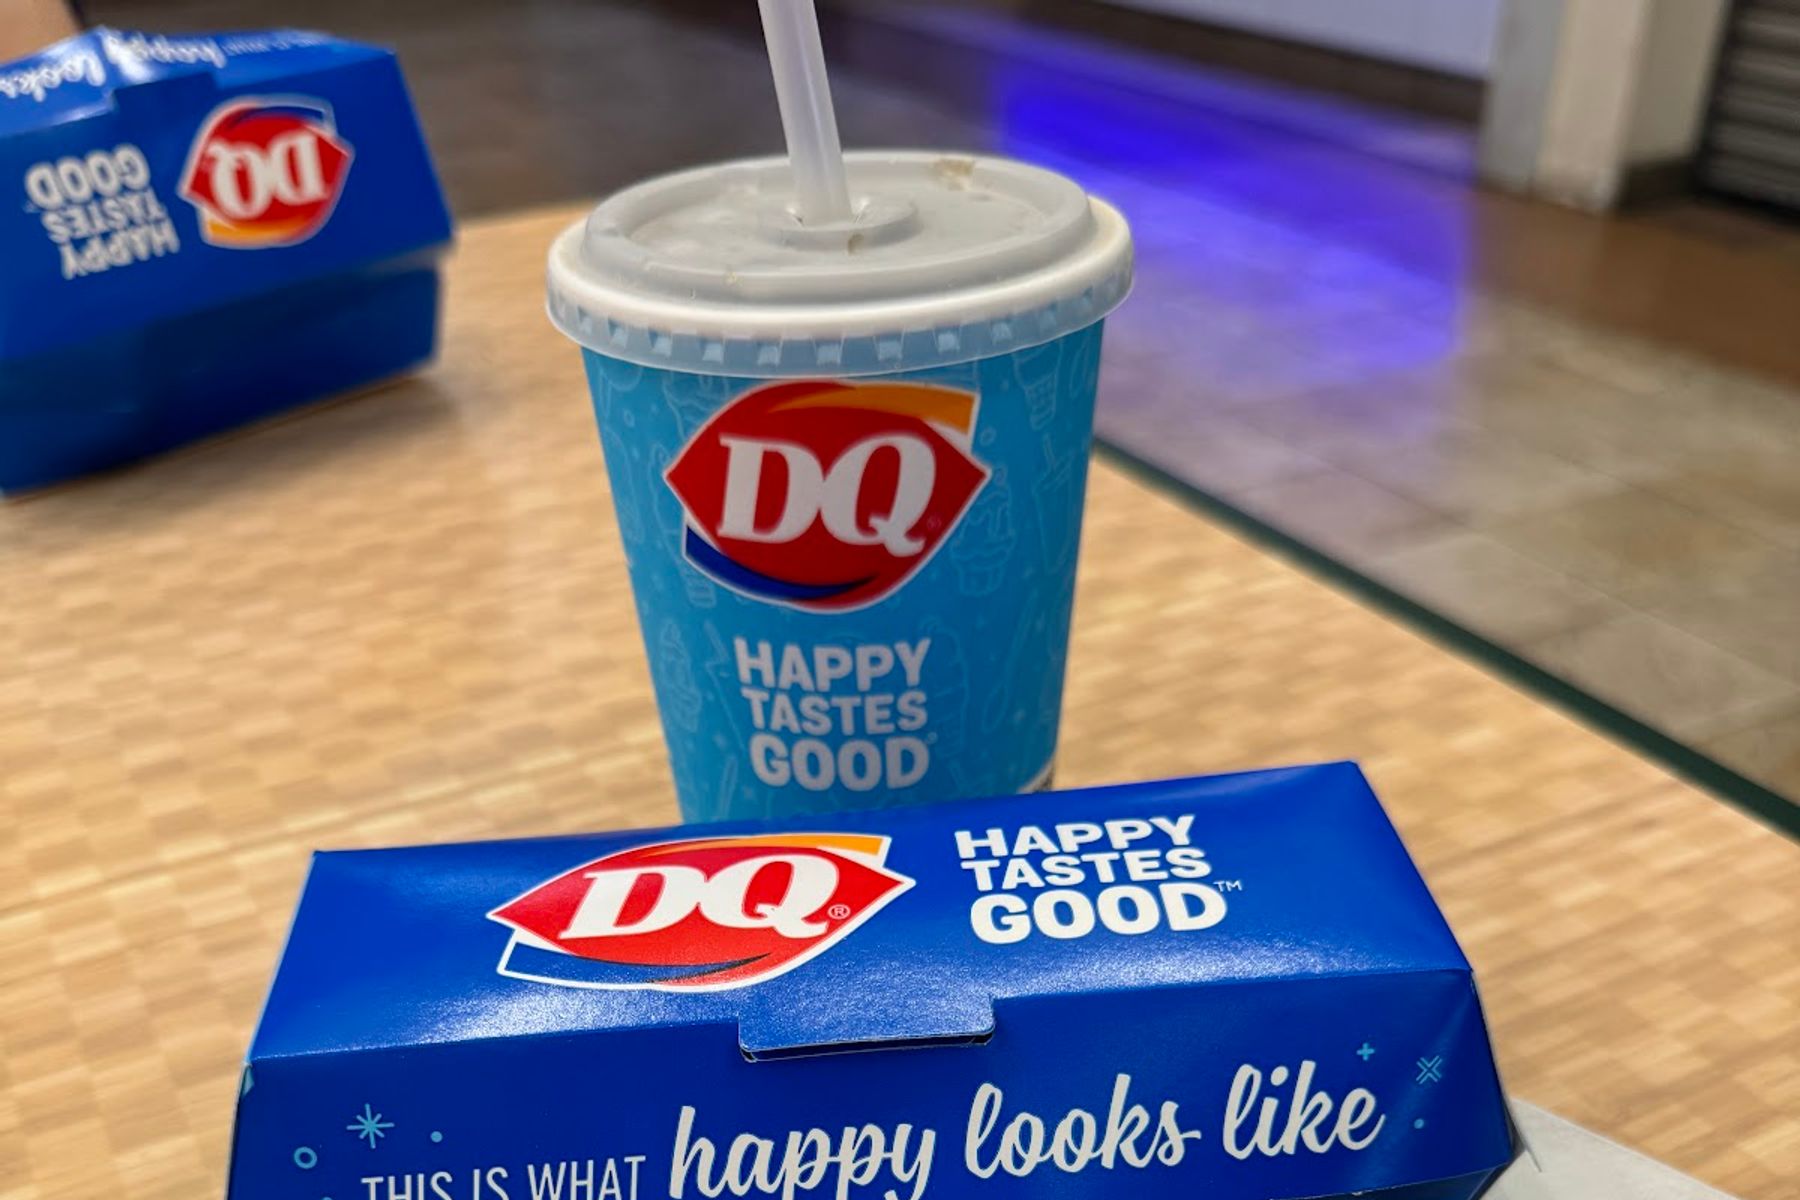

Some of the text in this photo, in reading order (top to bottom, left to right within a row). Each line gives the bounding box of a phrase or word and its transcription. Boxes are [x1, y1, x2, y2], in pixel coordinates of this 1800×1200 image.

[25, 144, 151, 208] GOOD
[205, 131, 328, 219] DQ
[41, 190, 171, 243] TASTES
[59, 223, 181, 281] HAPPY
[717, 432, 937, 557] DQ
[733, 636, 931, 692] HAPPY
[741, 686, 928, 736] TASTES
[749, 734, 930, 791] GOOD
[956, 814, 1197, 860] HAPPY
[560, 854, 842, 941] DQ
[961, 849, 1212, 892] TASTES
[970, 884, 1228, 945] GOOD
[964, 1072, 1203, 1179] looks
[1221, 1060, 1387, 1160] like
